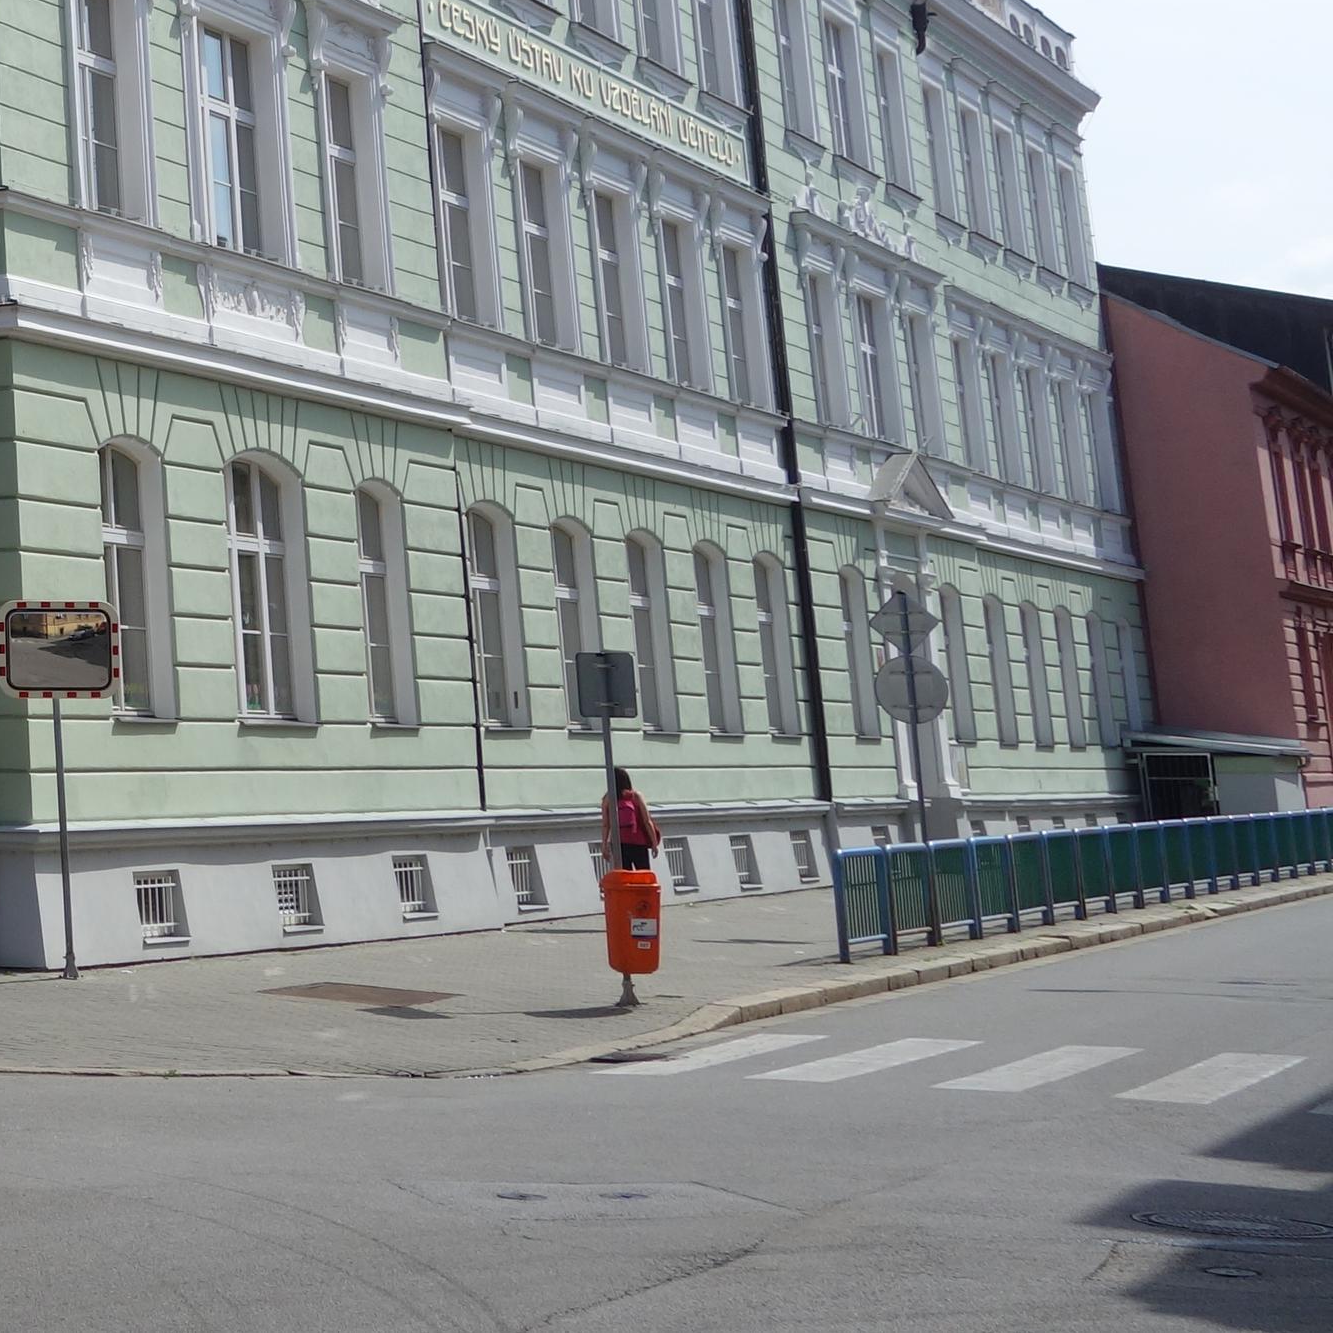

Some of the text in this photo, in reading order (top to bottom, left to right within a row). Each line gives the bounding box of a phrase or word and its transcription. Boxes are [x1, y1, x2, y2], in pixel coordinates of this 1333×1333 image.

[508, 27, 563, 83] ÚSTAV
[570, 62, 593, 97] KU
[599, 77, 671, 138] VZDĚLÁNÍ
[678, 115, 733, 165] UČITELŮ
